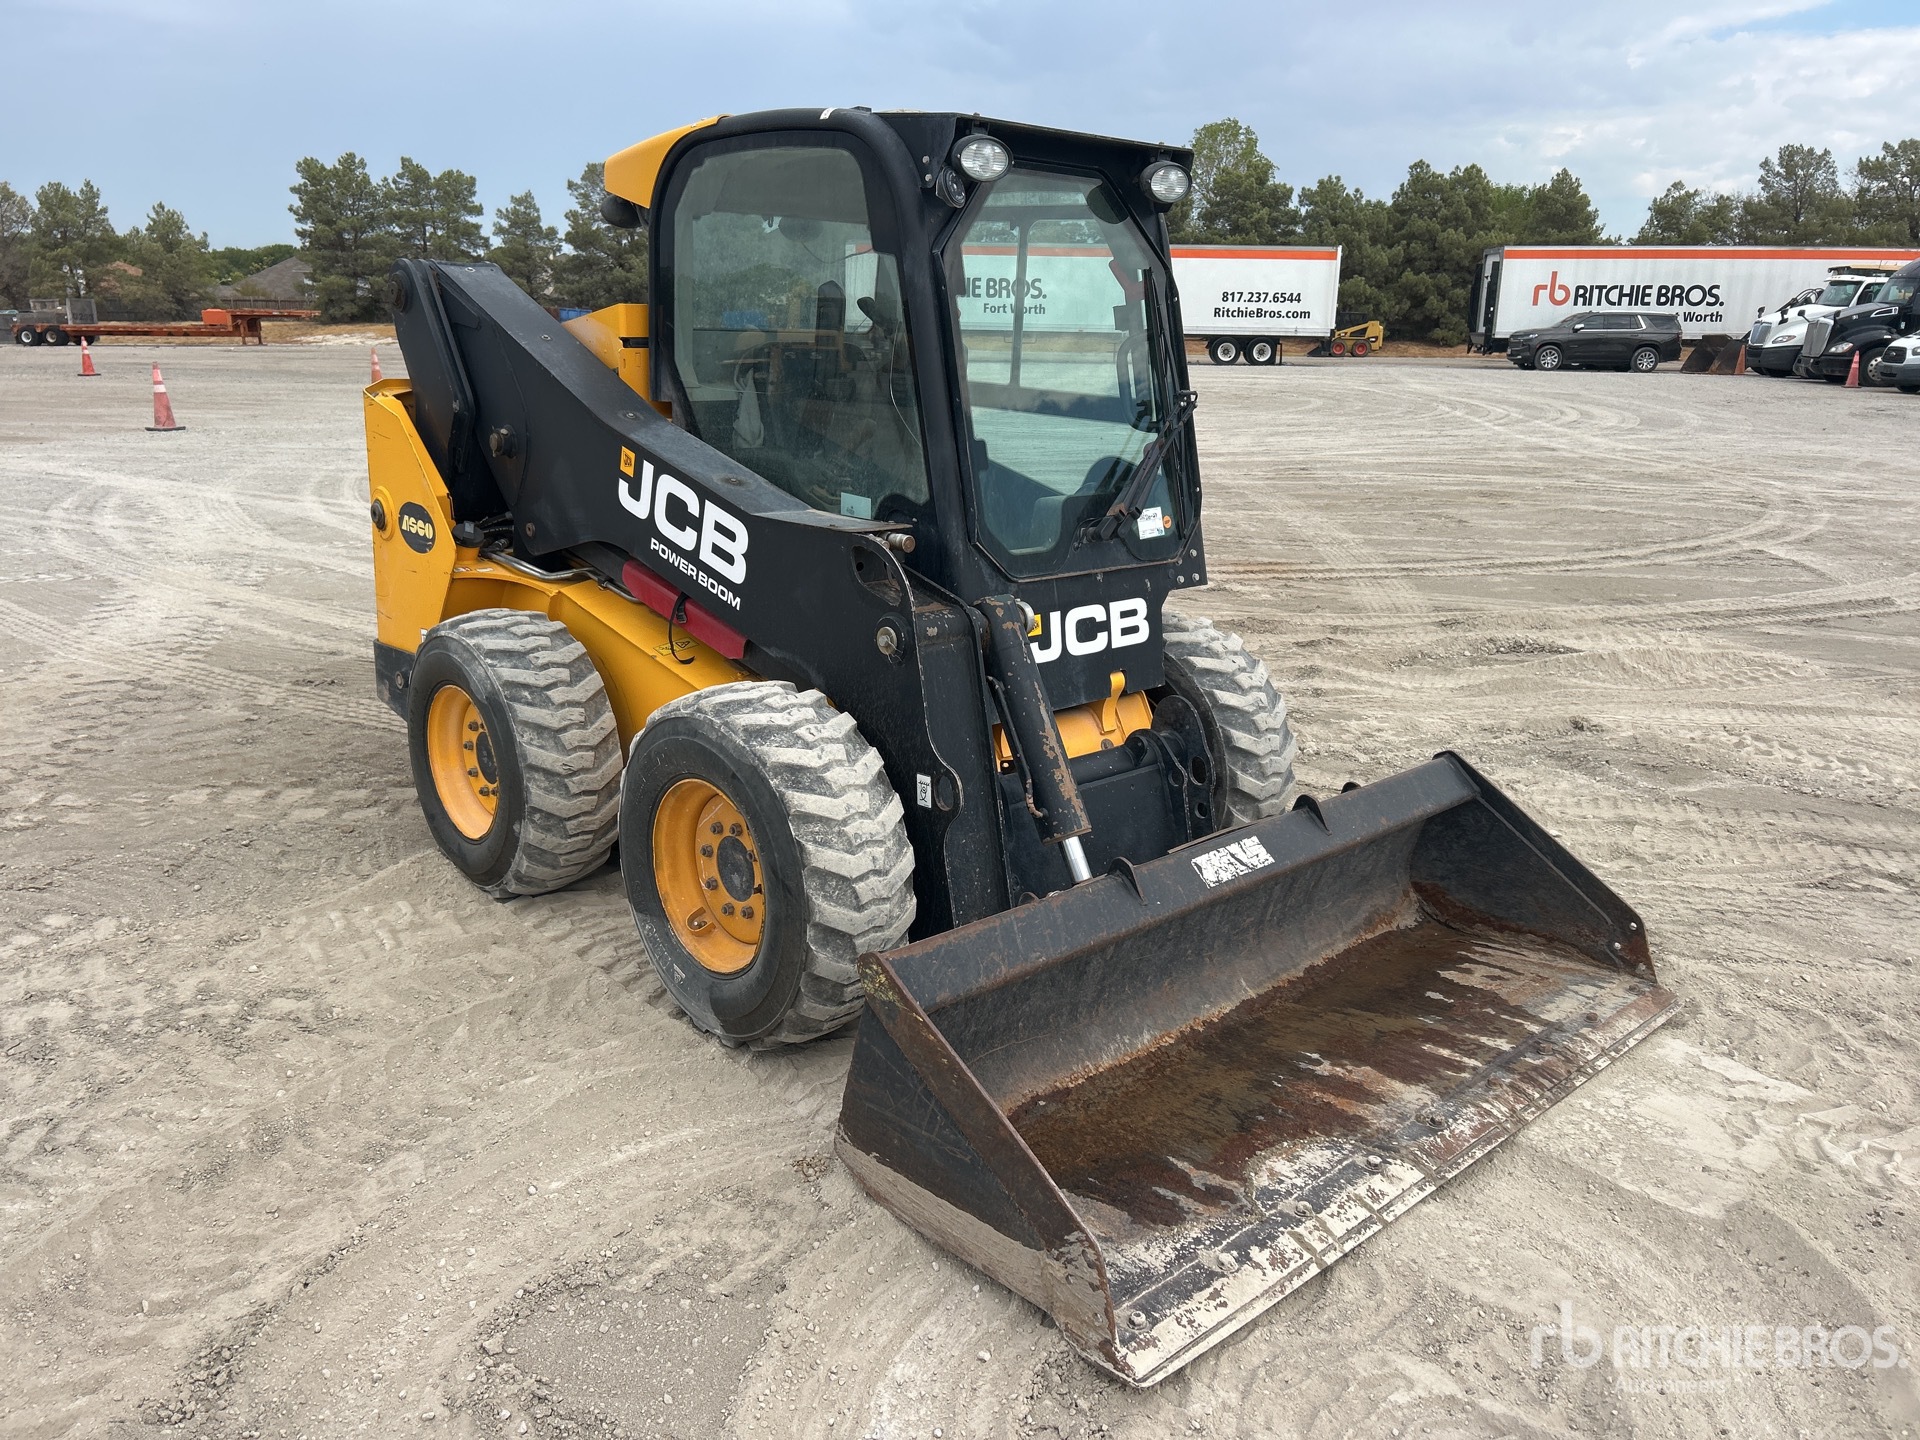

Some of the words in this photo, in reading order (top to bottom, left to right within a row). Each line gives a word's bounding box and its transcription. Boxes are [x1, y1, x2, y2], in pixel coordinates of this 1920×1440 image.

[1532, 271, 1571, 306] rb
[1573, 284, 1653, 307] RITCHIE
[1656, 284, 1725, 307] BROS.
[1221, 291, 1302, 304] 817.237.6544
[983, 303, 1007, 314] Fort
[1213, 306, 1311, 319] RitchieBros.com
[1683, 311, 1723, 323] Worth
[618, 459, 749, 585] JCB
[1029, 597, 1150, 664] JCB
